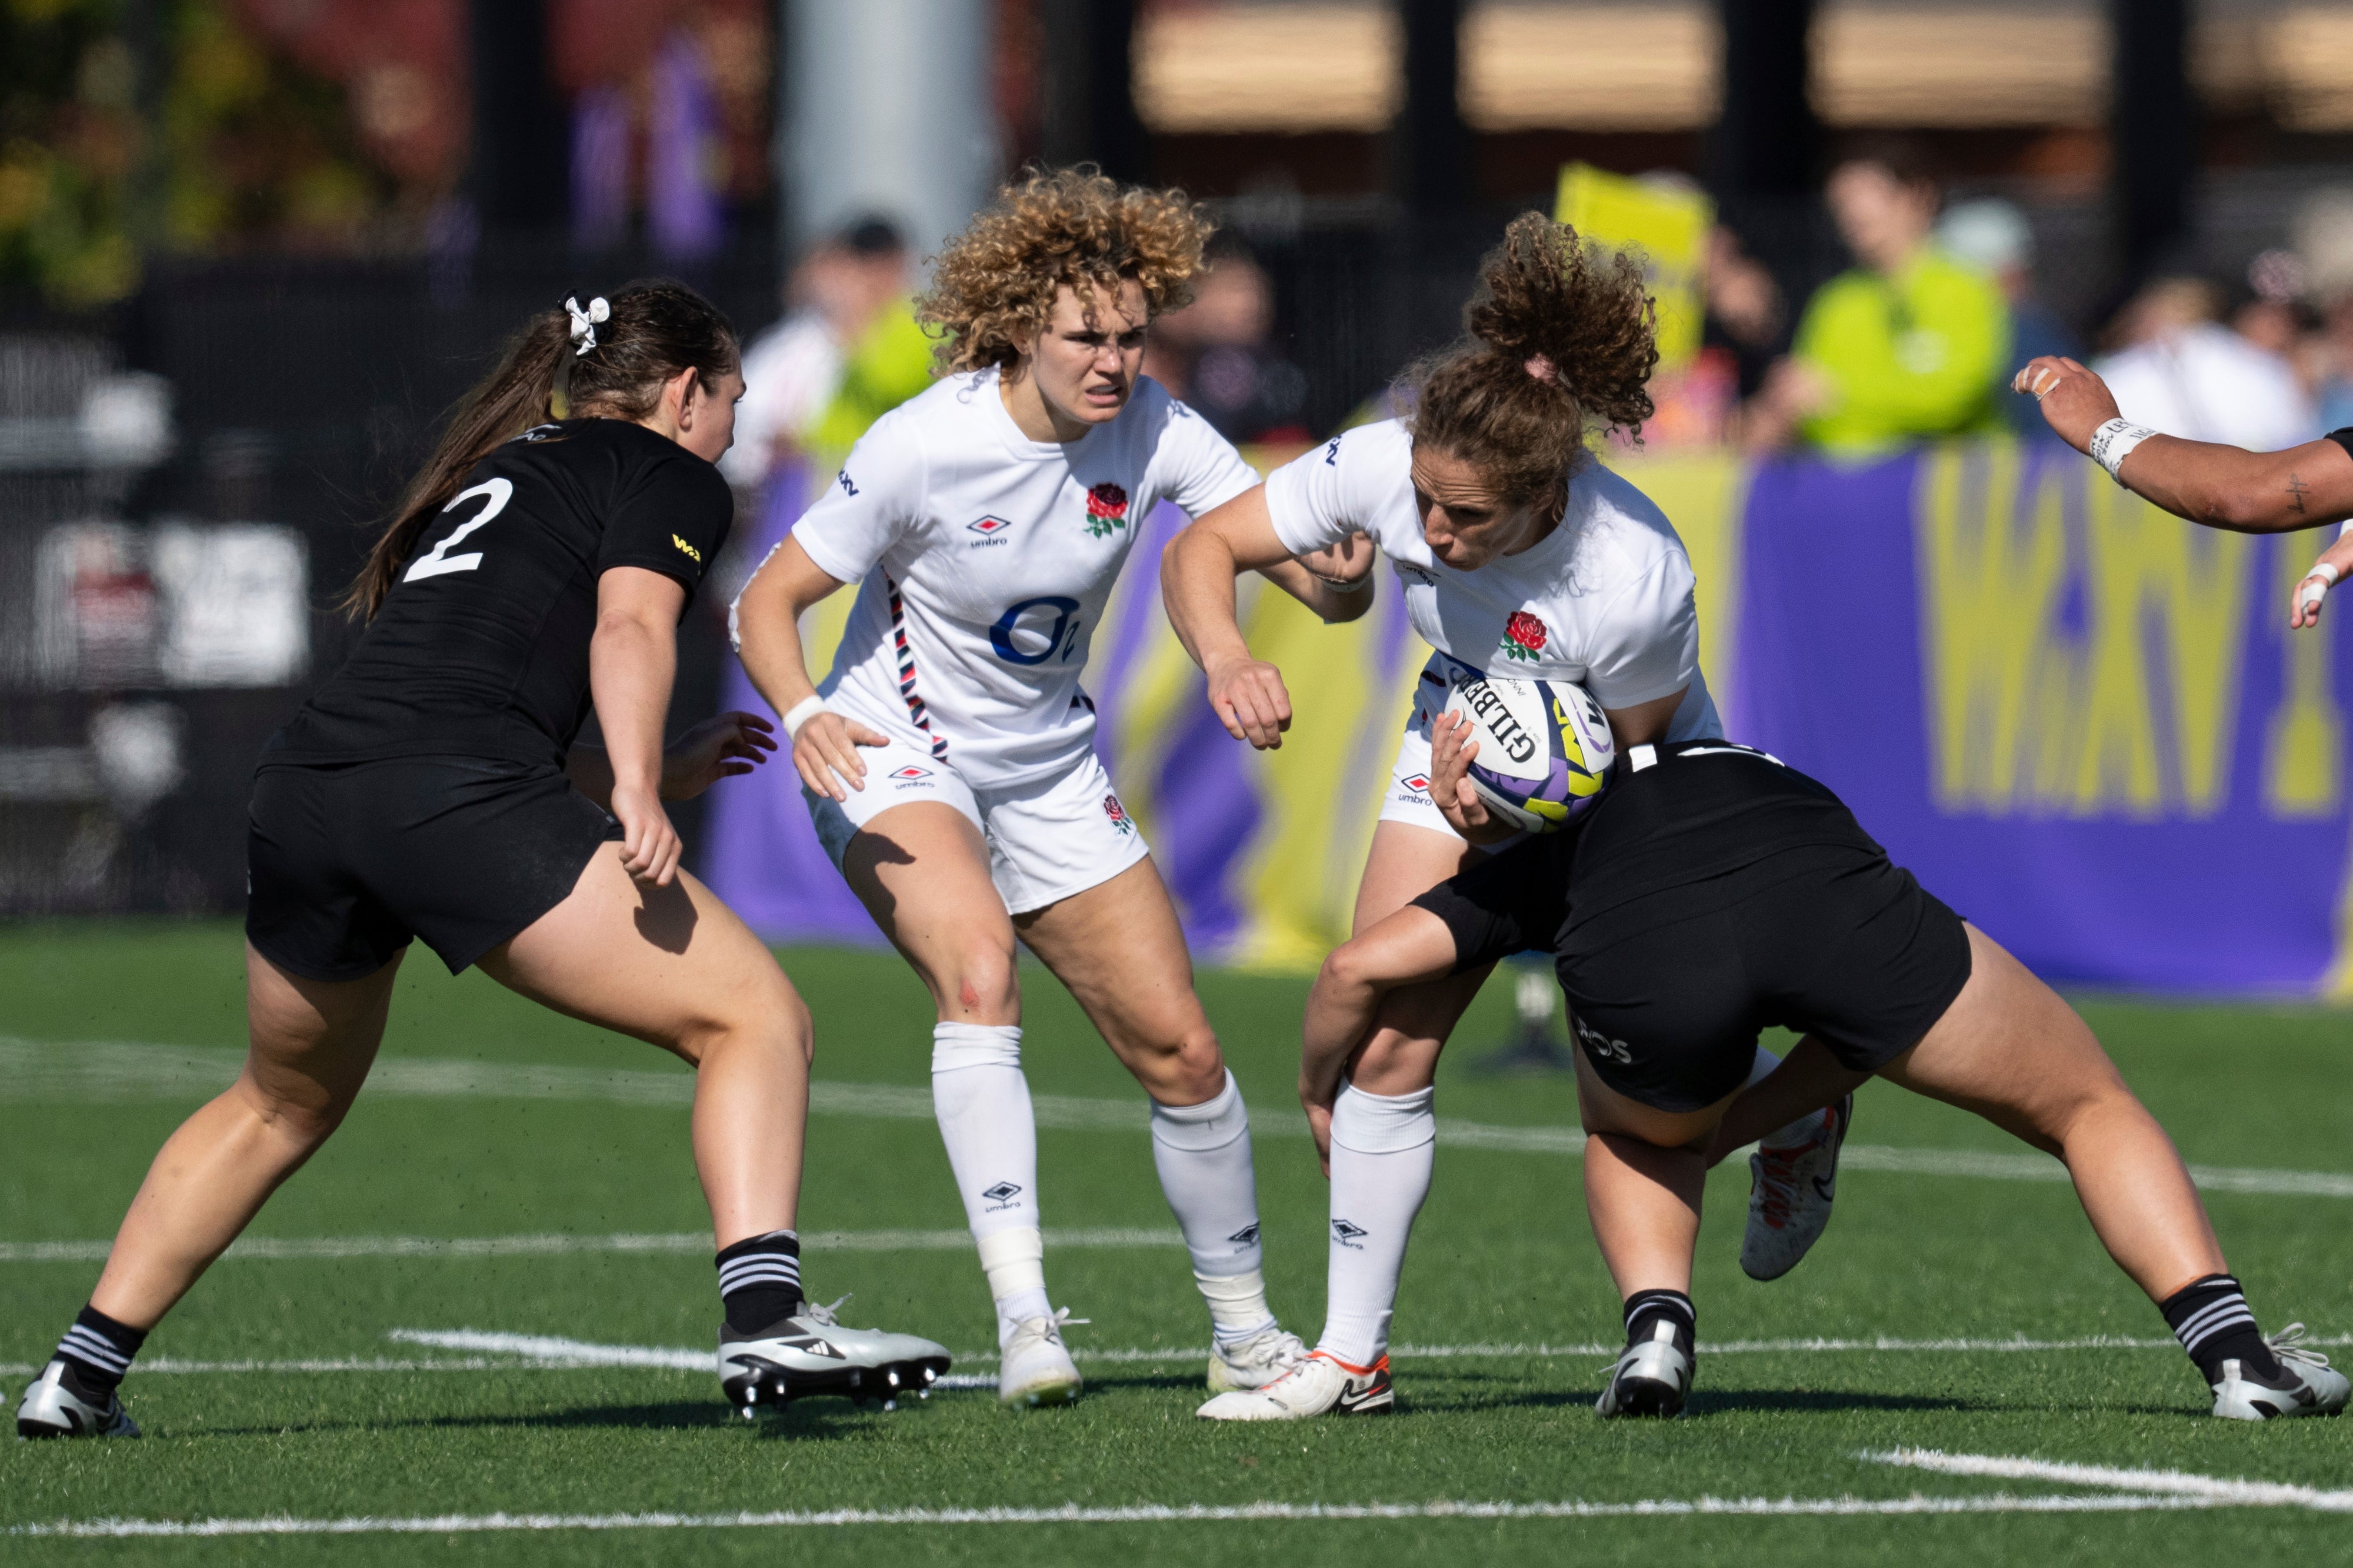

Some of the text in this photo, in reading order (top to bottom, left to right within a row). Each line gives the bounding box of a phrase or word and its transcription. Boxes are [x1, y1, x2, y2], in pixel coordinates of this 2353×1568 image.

[402, 478, 513, 583] 2
[970, 536, 1007, 549] umbro
[895, 781, 935, 790] umbro
[1398, 793, 1432, 806] umbro
[985, 1201, 1021, 1213] umbro
[1332, 1234, 1365, 1250] umbro
